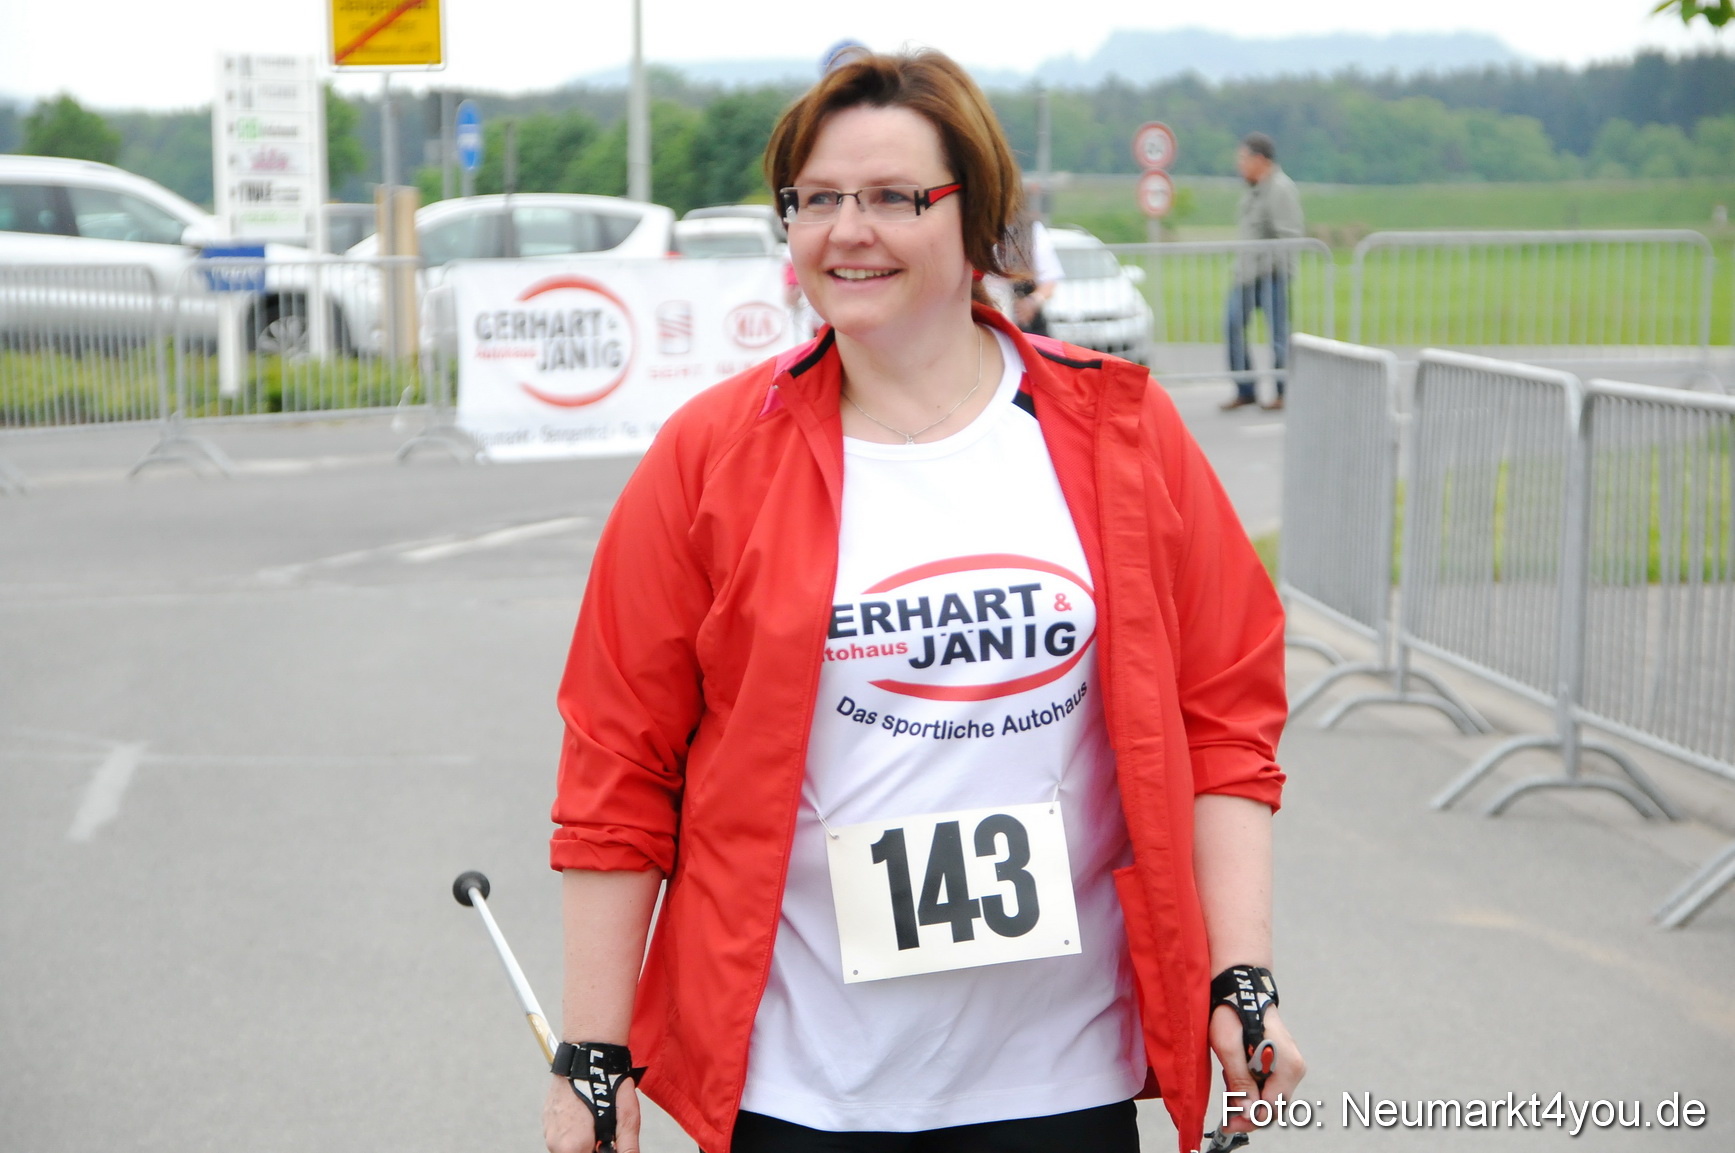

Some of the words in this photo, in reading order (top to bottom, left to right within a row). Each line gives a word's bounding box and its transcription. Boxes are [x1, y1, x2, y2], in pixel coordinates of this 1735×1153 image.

[475, 309, 602, 341] GERHART
[827, 582, 1043, 639] ERHART
[1053, 593, 1072, 612] &
[822, 641, 908, 663] tohaus
[908, 621, 1077, 669] JÄNIG
[836, 696, 877, 724] Das
[882, 713, 995, 740] sportliche
[1001, 681, 1088, 735] Autohaus
[870, 813, 1040, 951] 143
[1233, 969, 1259, 1011] LEKI
[589, 1049, 610, 1108] LEKI
